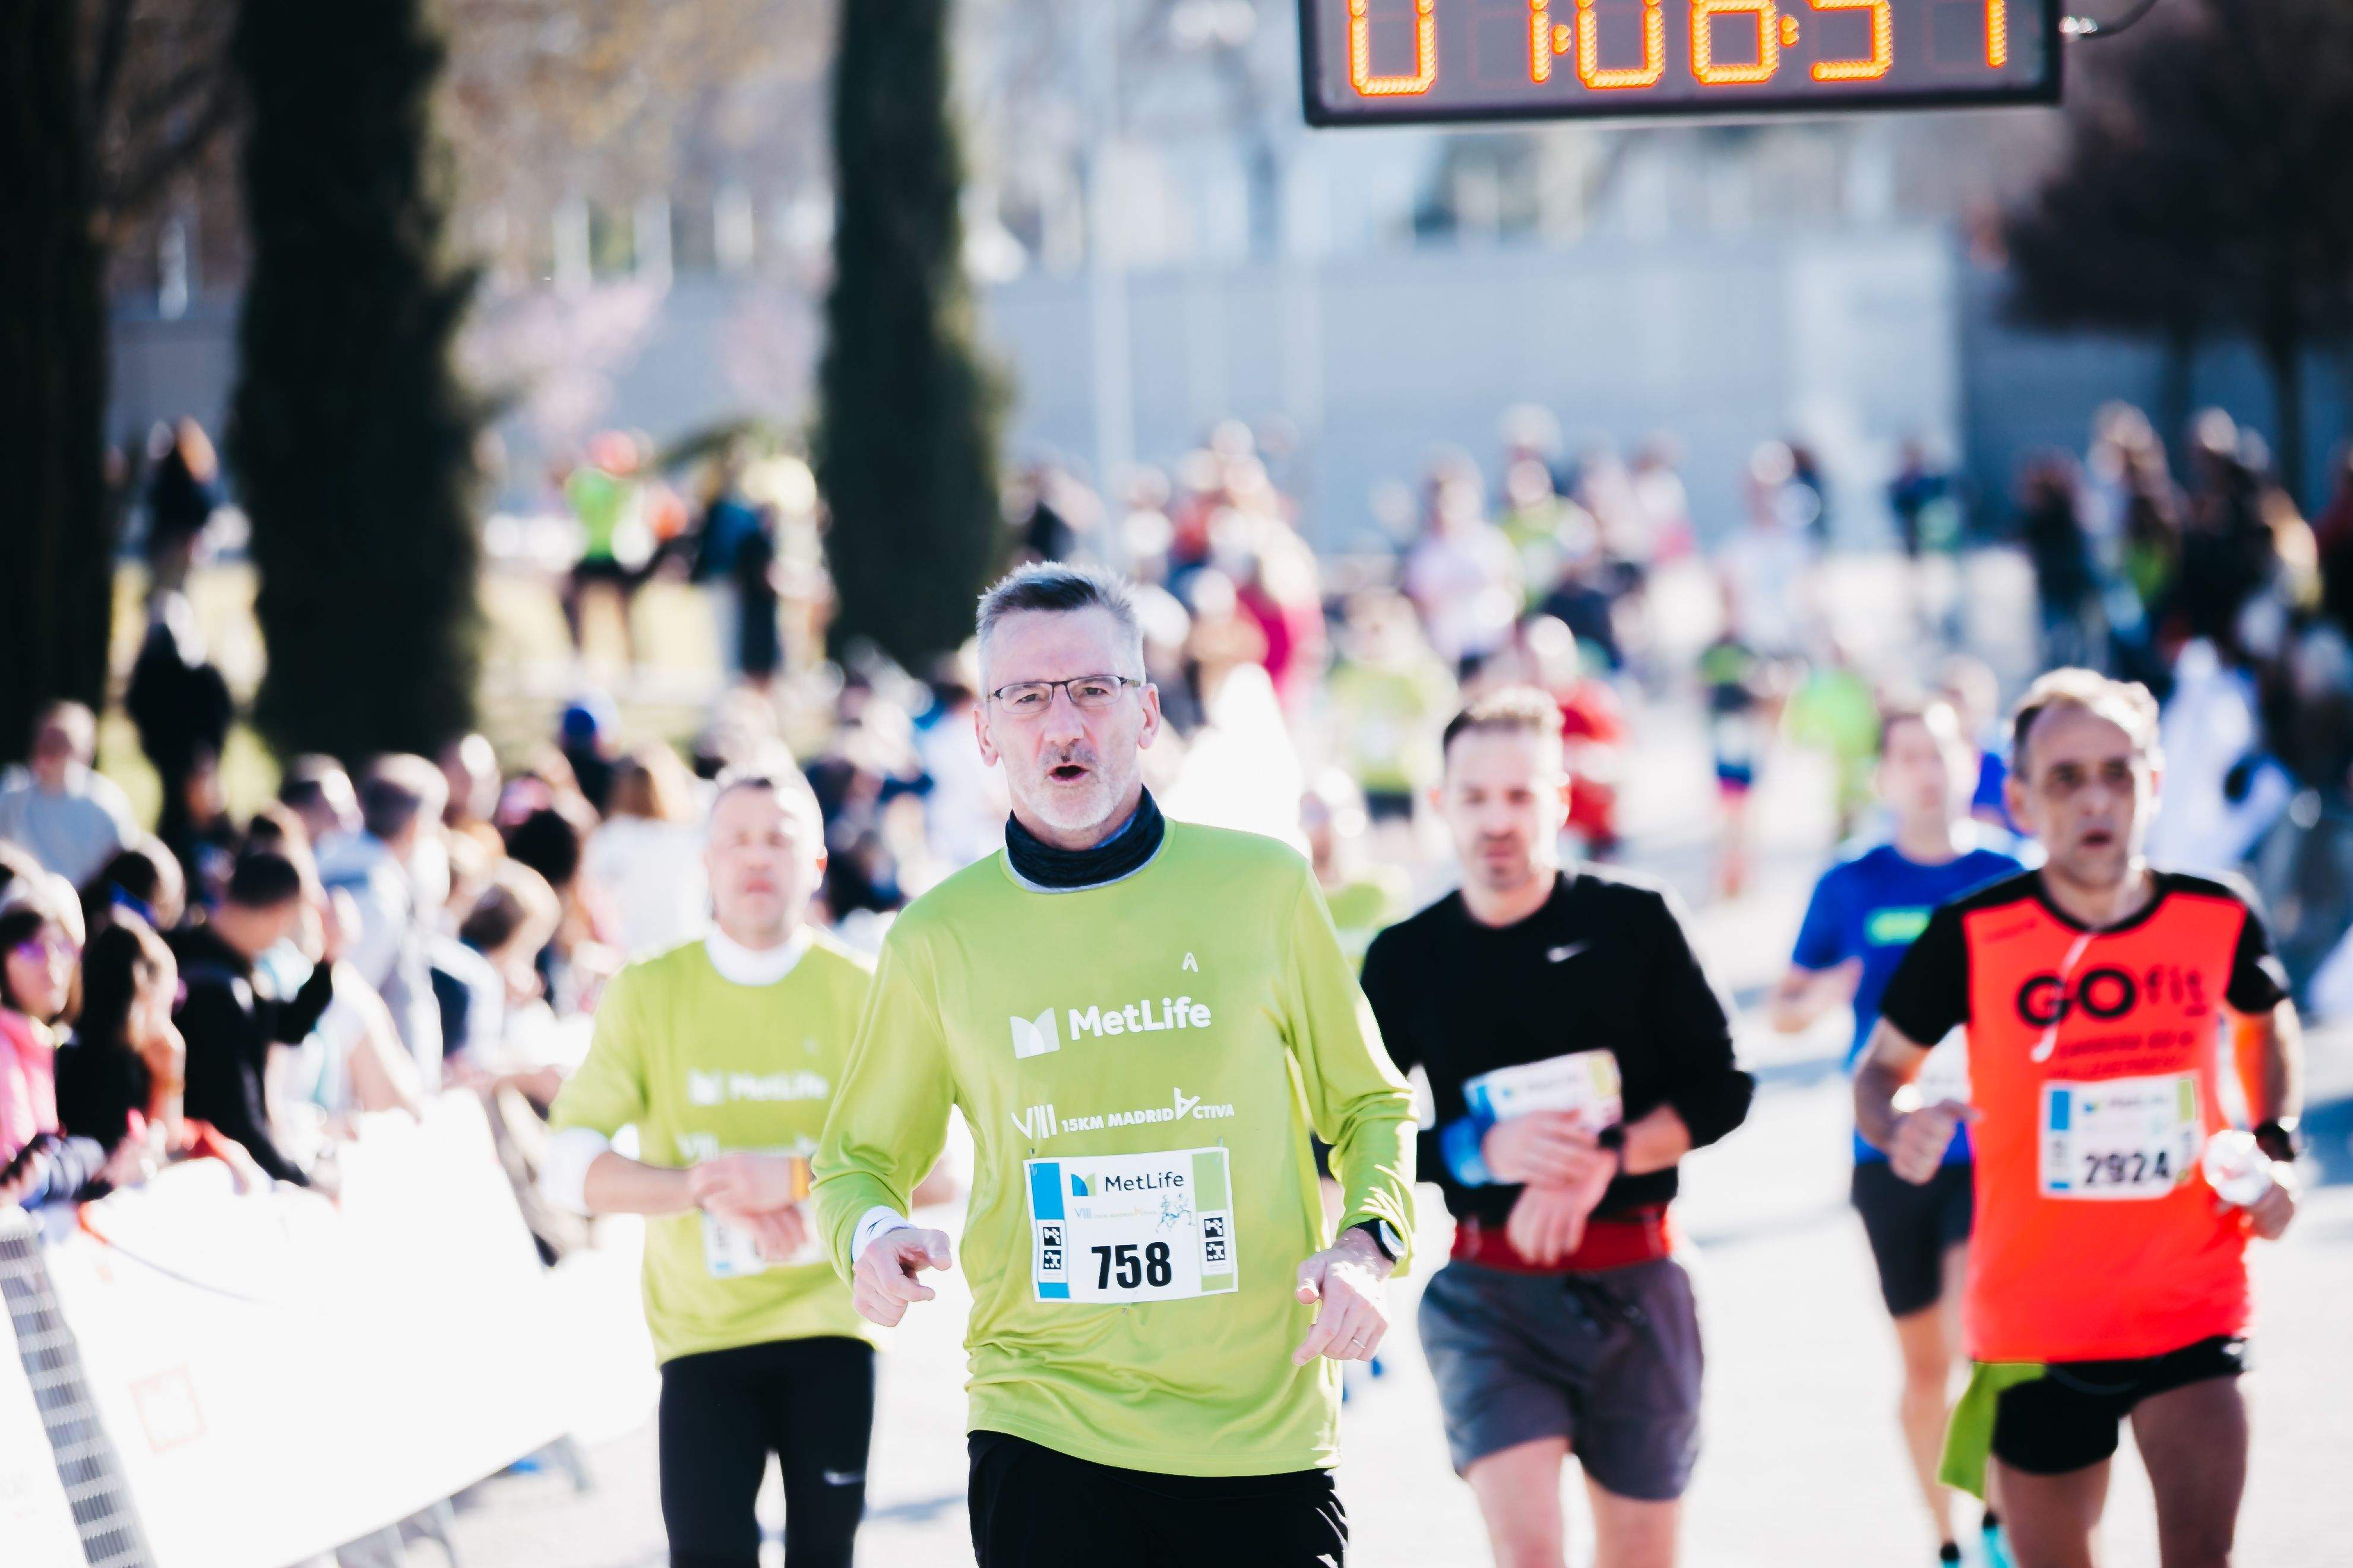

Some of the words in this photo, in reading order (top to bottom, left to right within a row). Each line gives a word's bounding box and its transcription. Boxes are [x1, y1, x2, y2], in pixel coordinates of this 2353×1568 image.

[1068, 996, 1212, 1041] MetLife
[1011, 1104, 1058, 1140] VIII
[1061, 1115, 1105, 1133] 15KM
[1105, 1171, 1184, 1192] MetLife
[1091, 1241, 1172, 1290] 758
